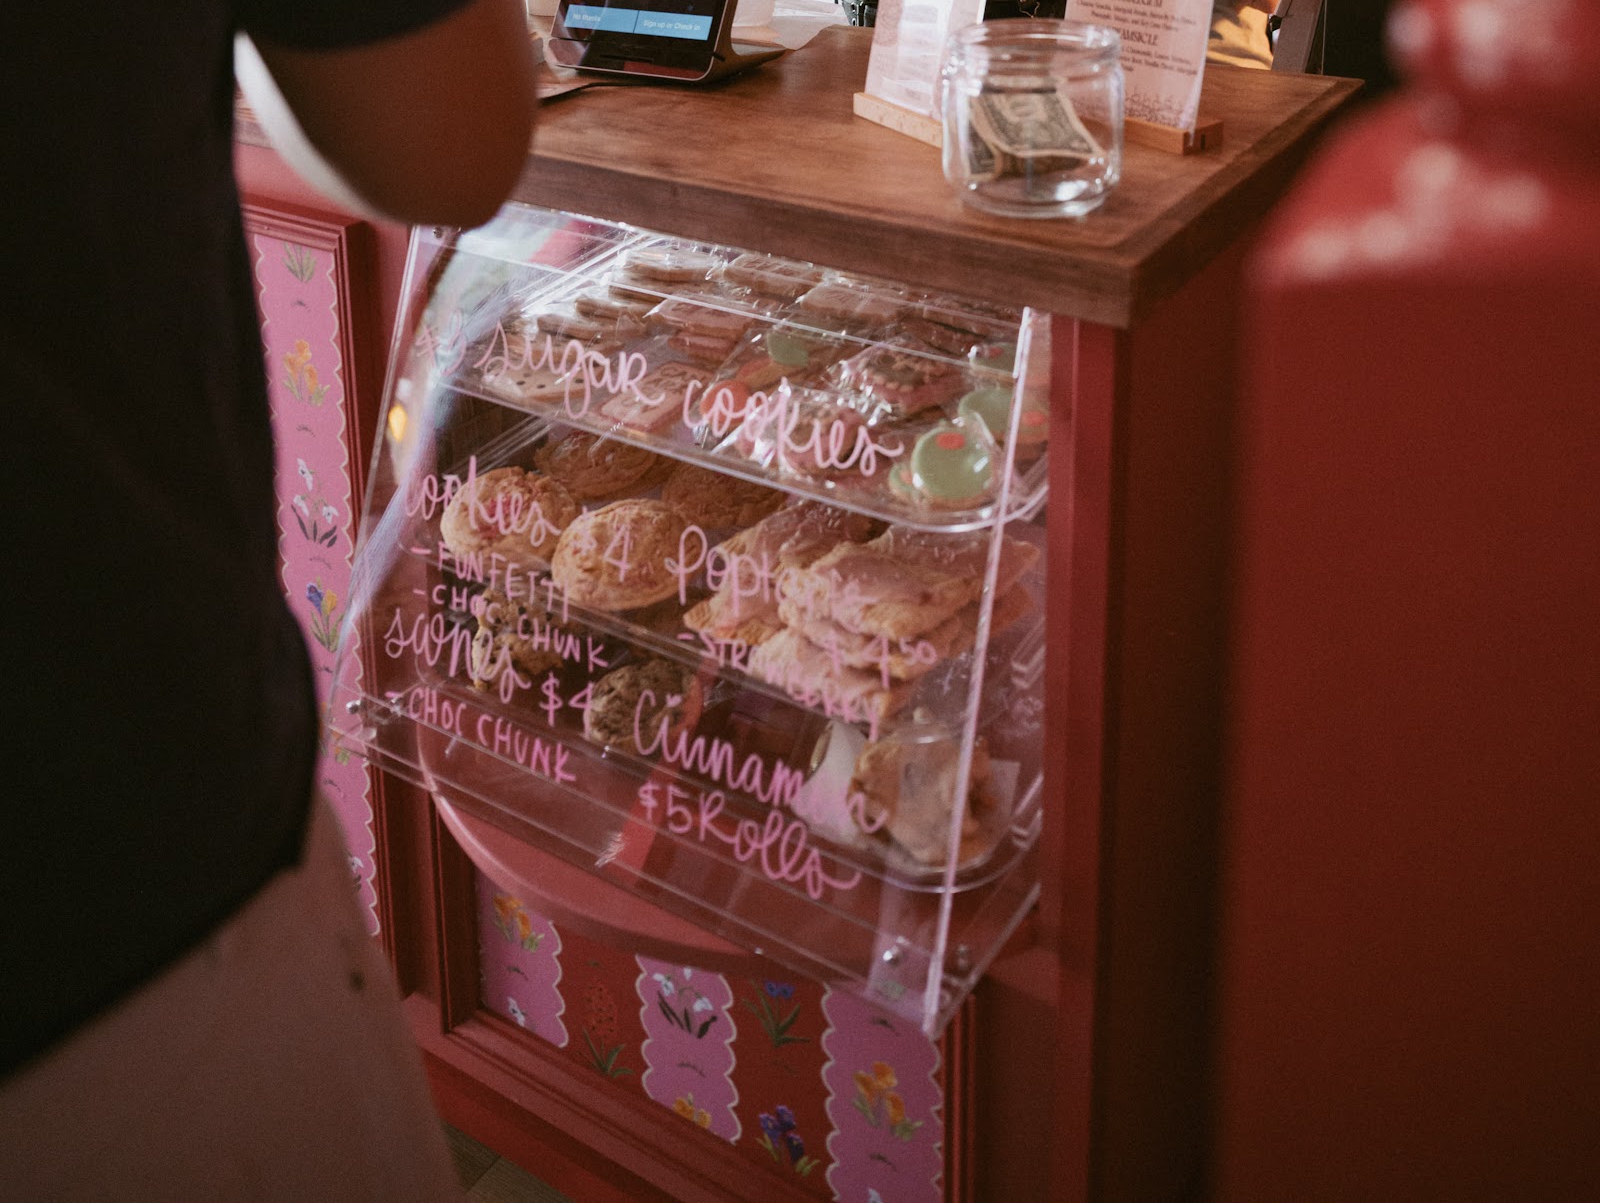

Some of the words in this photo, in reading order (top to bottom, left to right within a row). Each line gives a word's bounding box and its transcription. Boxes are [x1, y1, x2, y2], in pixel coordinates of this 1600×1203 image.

[643, 19, 657, 28] Sign
[657, 22, 665, 30] up
[674, 22, 693, 30] Check
[693, 23, 701, 31] in
[518, 614, 609, 673] CHUNK
[539, 671, 595, 741] $4
[477, 713, 577, 784] CHUNK
[637, 781, 694, 834] $5
